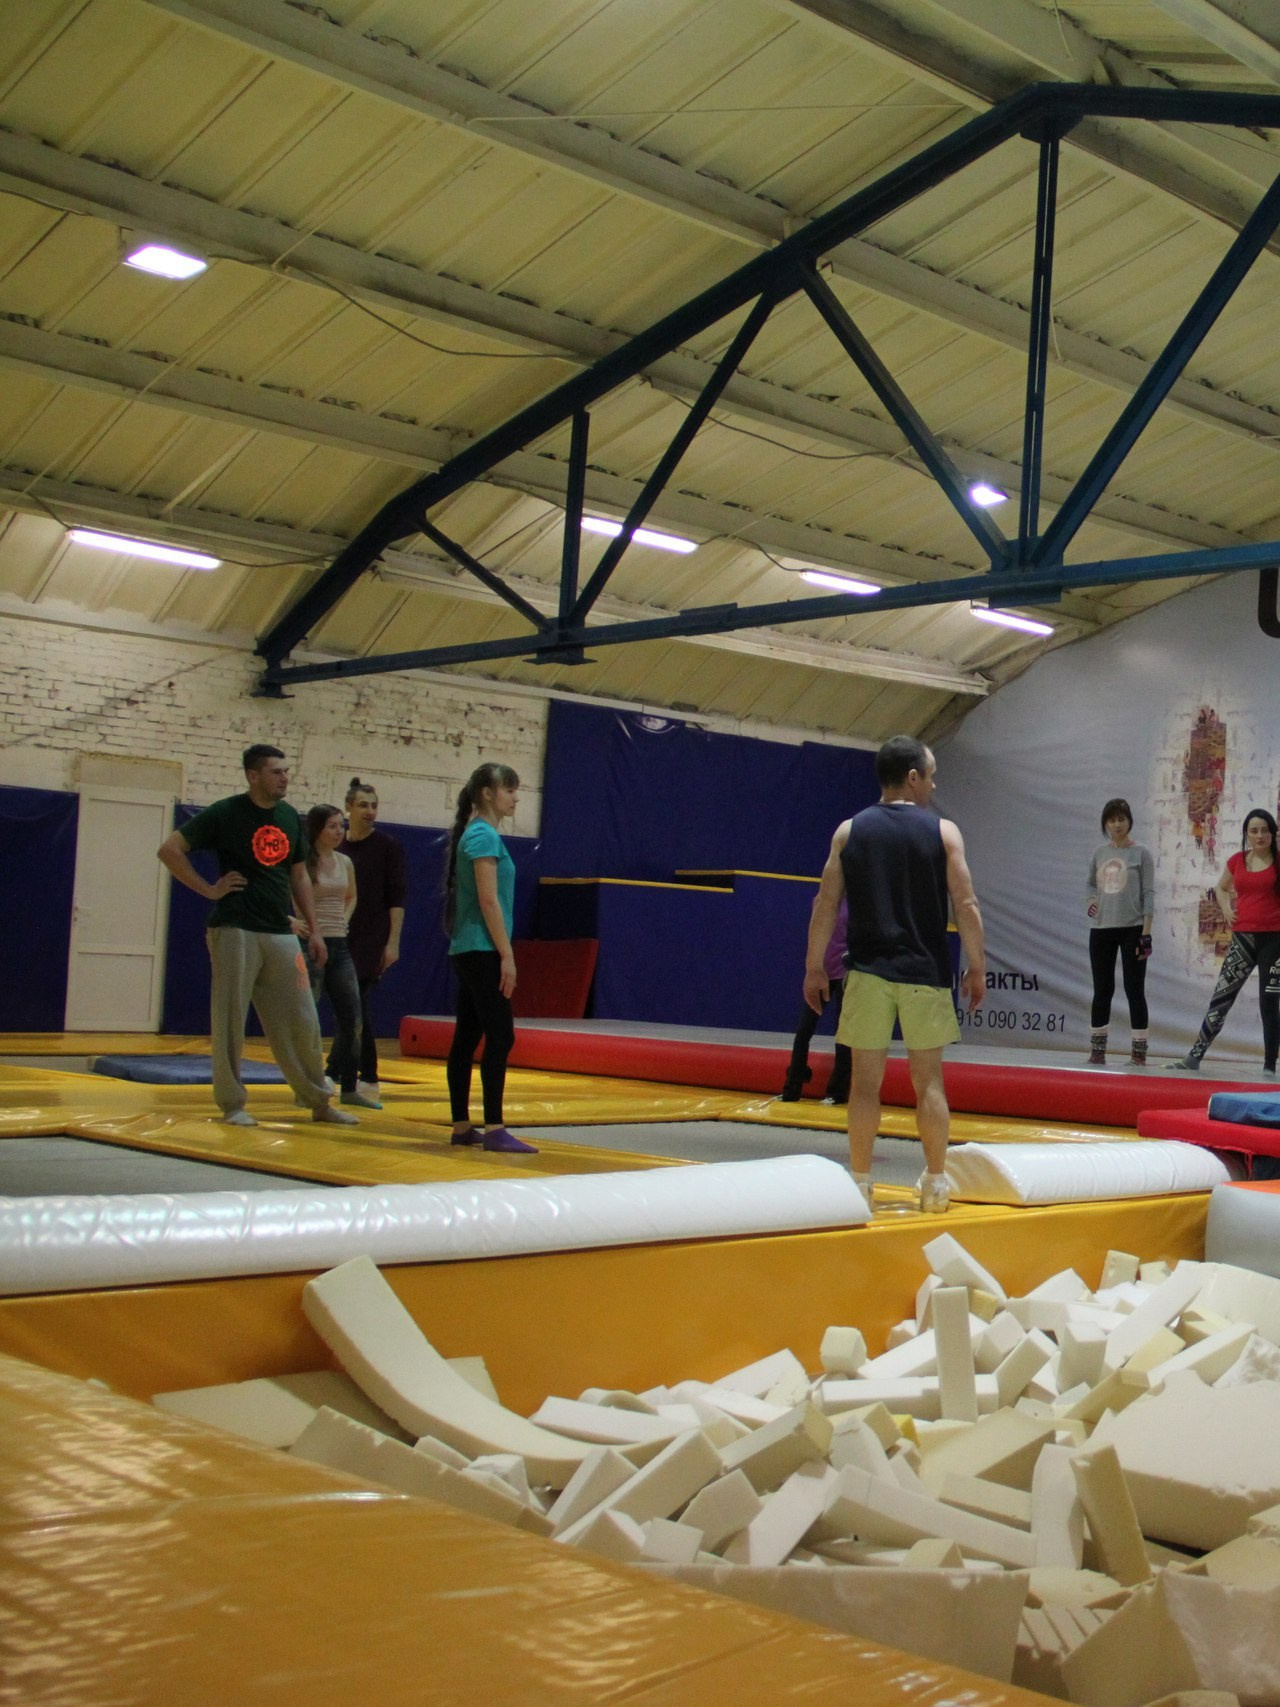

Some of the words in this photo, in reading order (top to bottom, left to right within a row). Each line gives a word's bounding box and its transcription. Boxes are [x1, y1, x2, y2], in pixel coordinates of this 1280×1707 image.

[988, 1009, 1017, 1030] 090
[1022, 1011, 1041, 1031] 32
[1046, 1013, 1066, 1033] 81
